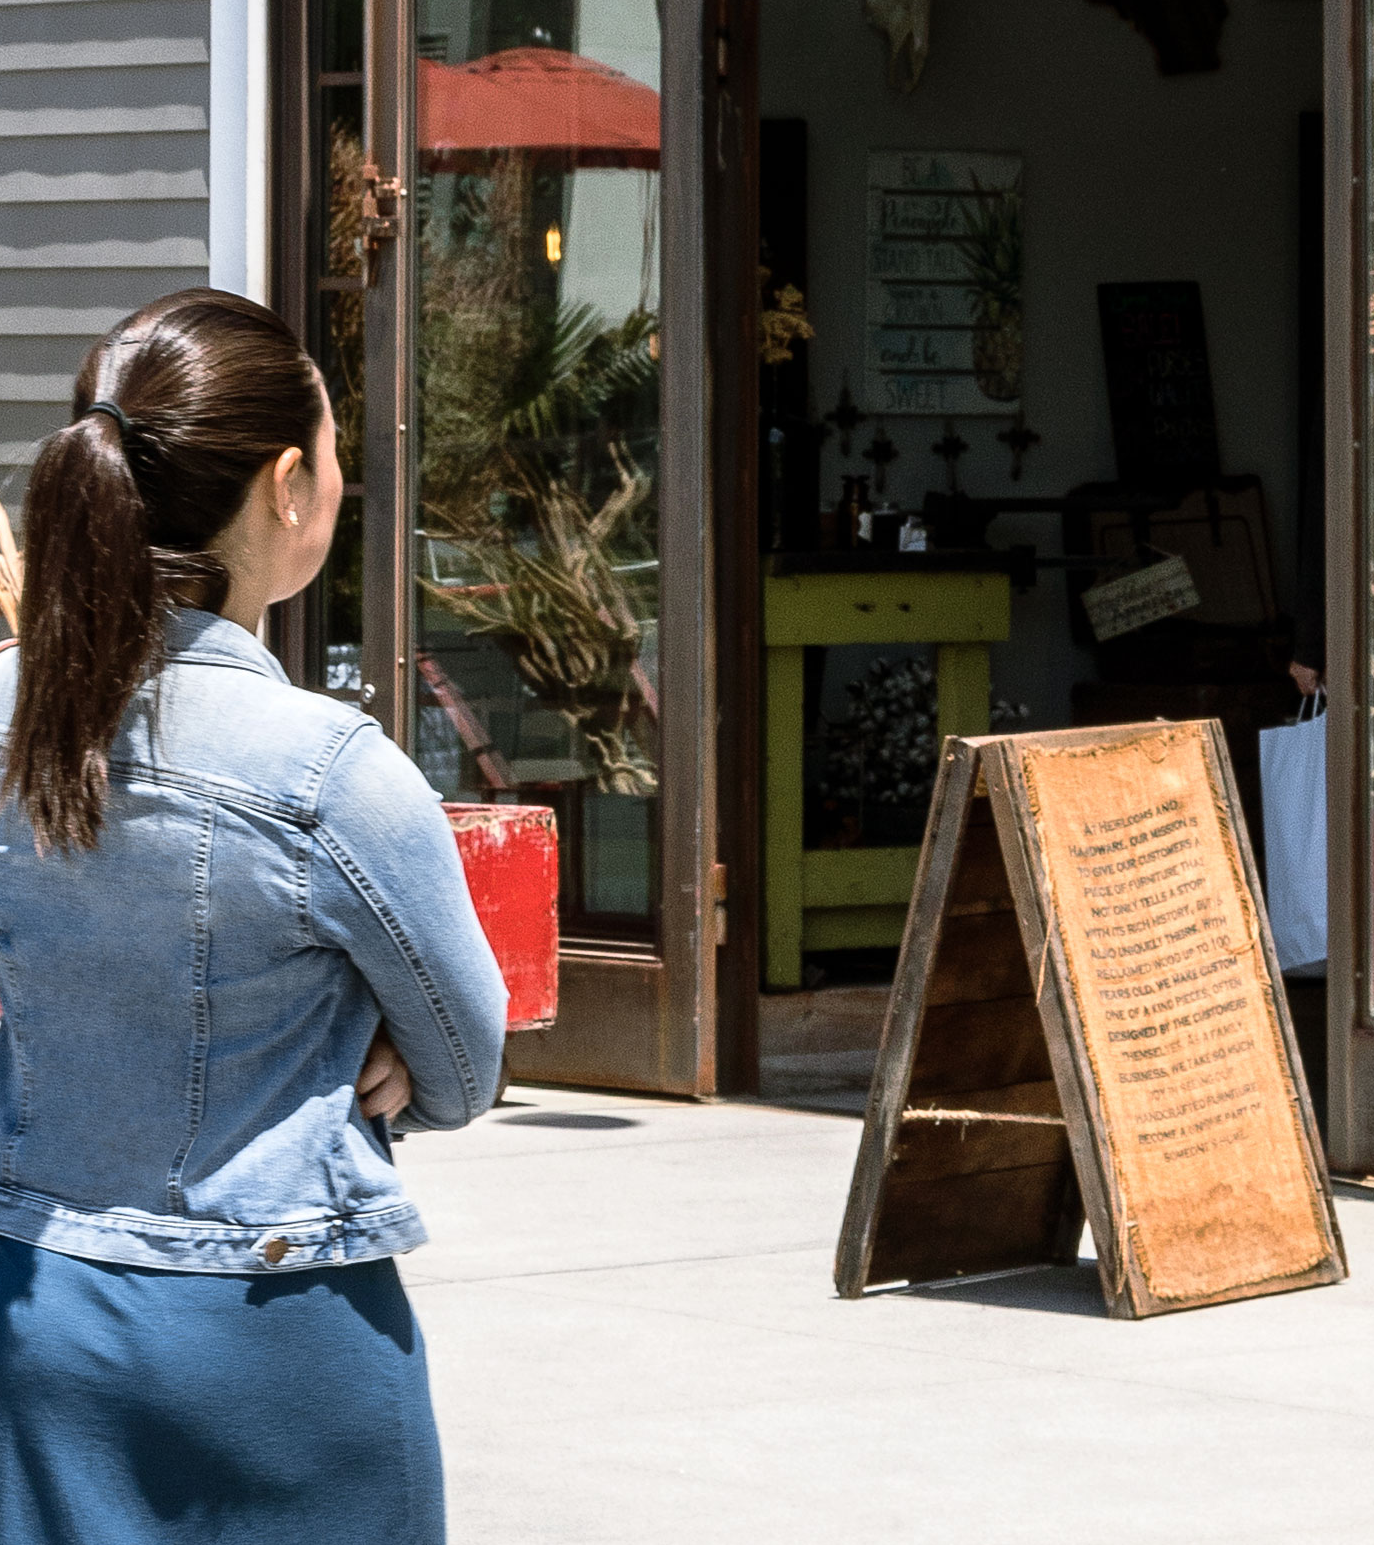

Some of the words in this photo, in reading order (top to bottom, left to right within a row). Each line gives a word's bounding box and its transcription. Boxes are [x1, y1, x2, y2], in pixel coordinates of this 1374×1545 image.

[883, 378, 949, 410] SWEET
[1099, 810, 1153, 832] HEIRLOOMS
[1156, 798, 1179, 815] AND
[1129, 832, 1149, 848] OUR
[1150, 818, 1188, 839] MISSION
[1092, 862, 1114, 878] GIVE
[1116, 857, 1137, 872] OUR
[1137, 838, 1192, 866] CUSTOMERS
[1113, 881, 1127, 896] OF
[1128, 865, 1179, 891] FURNITURE
[1139, 890, 1168, 910] TELLS
[1127, 918, 1150, 936] RICH
[1096, 962, 1153, 982] RECLAIMED
[1211, 934, 1231, 952] 100
[1155, 978, 1170, 992] WE
[1173, 969, 1199, 986] MAKE
[1200, 956, 1238, 977] CUSTOM
[1142, 1003, 1151, 1017] A
[1212, 977, 1242, 995] OFTEN
[1108, 1024, 1157, 1043] DESIGNED
[1158, 1022, 1172, 1035] BY
[1173, 1014, 1191, 1029] THE
[1192, 996, 1248, 1024] CUSTOMERS
[1171, 1061, 1187, 1075] WE
[1212, 1047, 1227, 1060] SO
[1137, 1128, 1177, 1146] BECOME
